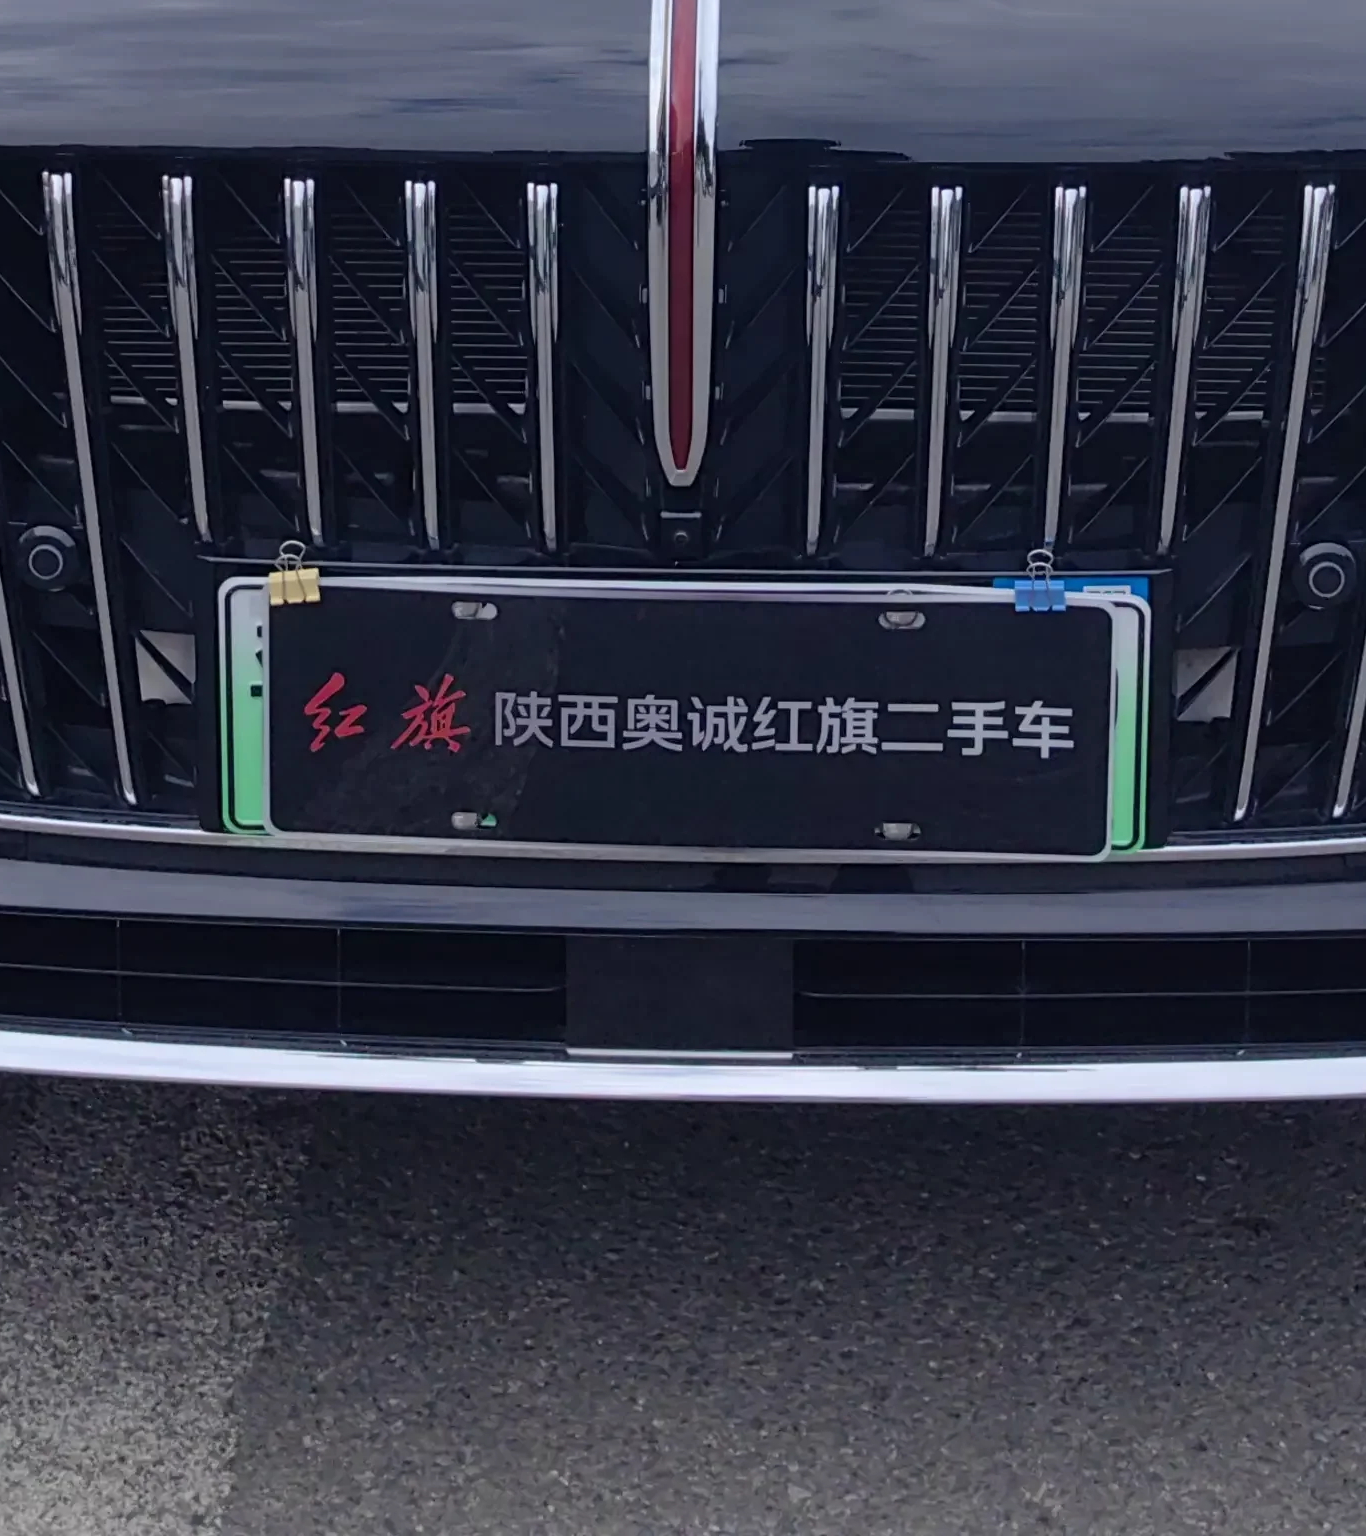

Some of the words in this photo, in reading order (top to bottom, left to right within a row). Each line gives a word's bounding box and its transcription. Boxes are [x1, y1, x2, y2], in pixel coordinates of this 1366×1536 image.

[303, 672, 471, 753] 红旗
[494, 690, 1075, 759] 陕西奥诚红旗二手车
